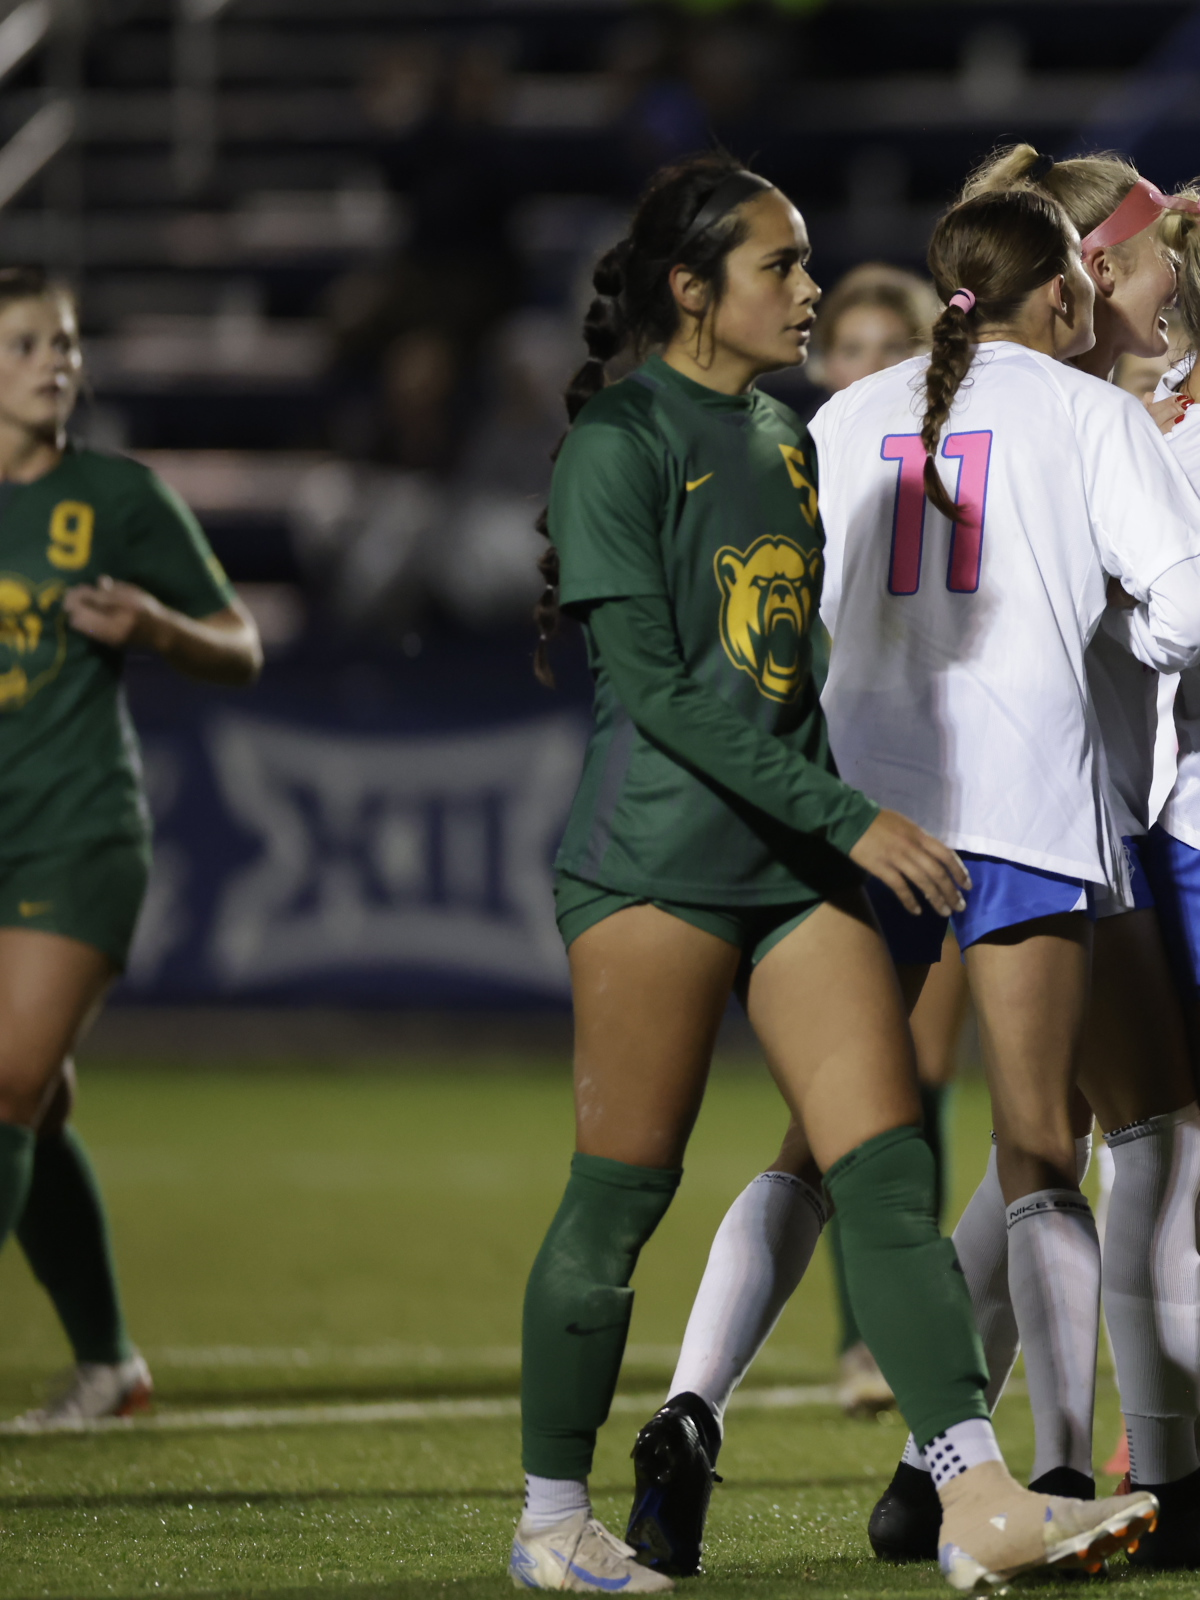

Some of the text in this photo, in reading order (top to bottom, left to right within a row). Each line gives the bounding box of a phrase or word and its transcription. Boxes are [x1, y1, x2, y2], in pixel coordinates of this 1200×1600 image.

[778, 443, 818, 528] 5
[880, 429, 993, 596] 11
[47, 499, 95, 571] 9
[1009, 1201, 1049, 1220] NIKE
